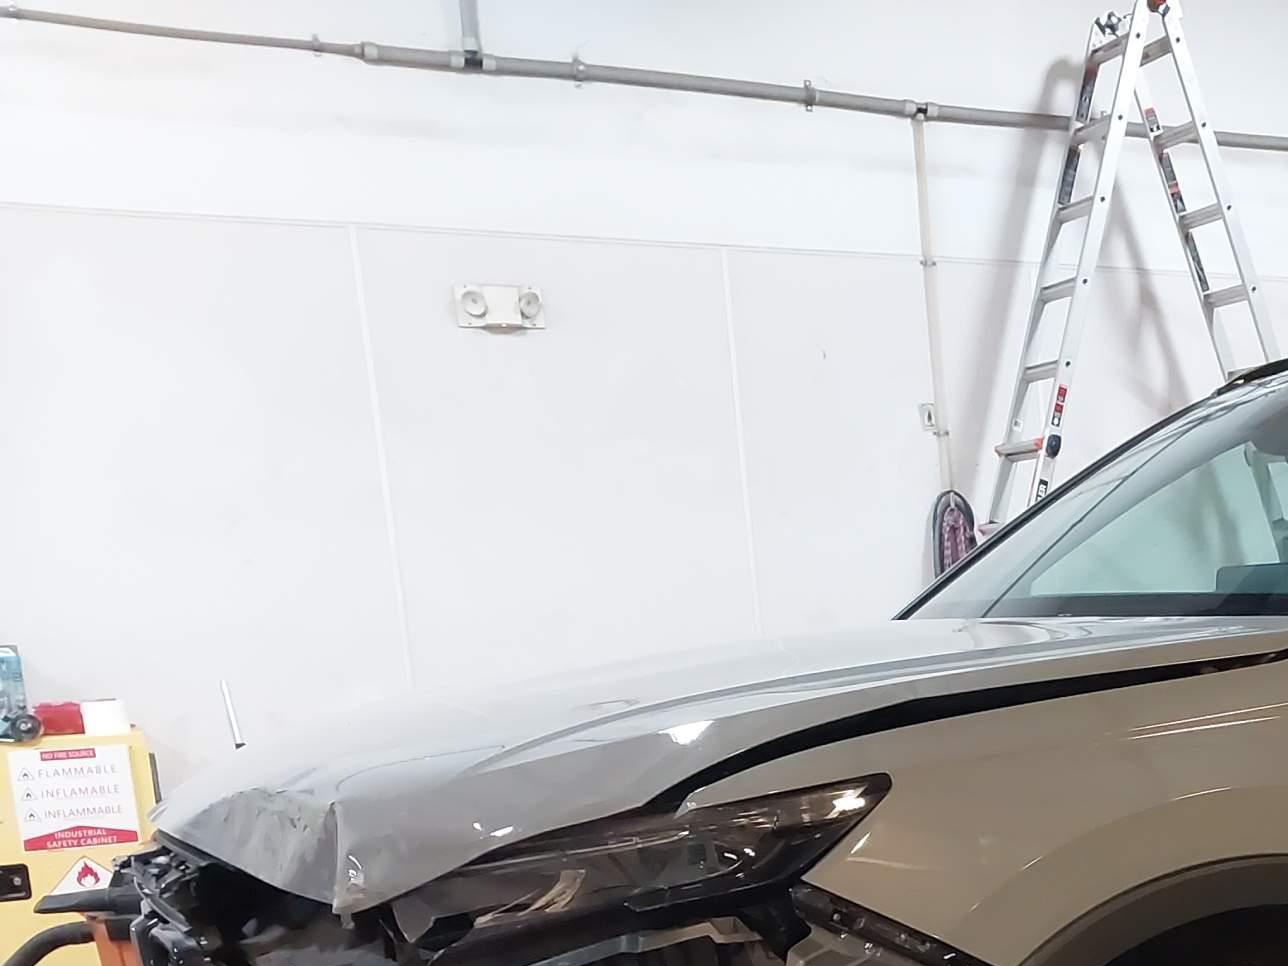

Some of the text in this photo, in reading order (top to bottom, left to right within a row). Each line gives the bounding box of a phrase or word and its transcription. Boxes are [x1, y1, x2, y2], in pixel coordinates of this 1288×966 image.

[54, 751, 66, 759] FIRE
[68, 749, 94, 757] SOURCE
[38, 764, 118, 778] FLAMMABLE
[41, 784, 120, 799] INFLAMABLE
[44, 805, 122, 819] INFLAMMABLE
[54, 829, 107, 839] INDUSTRIAL
[46, 836, 118, 848] SAFETY CABINET
